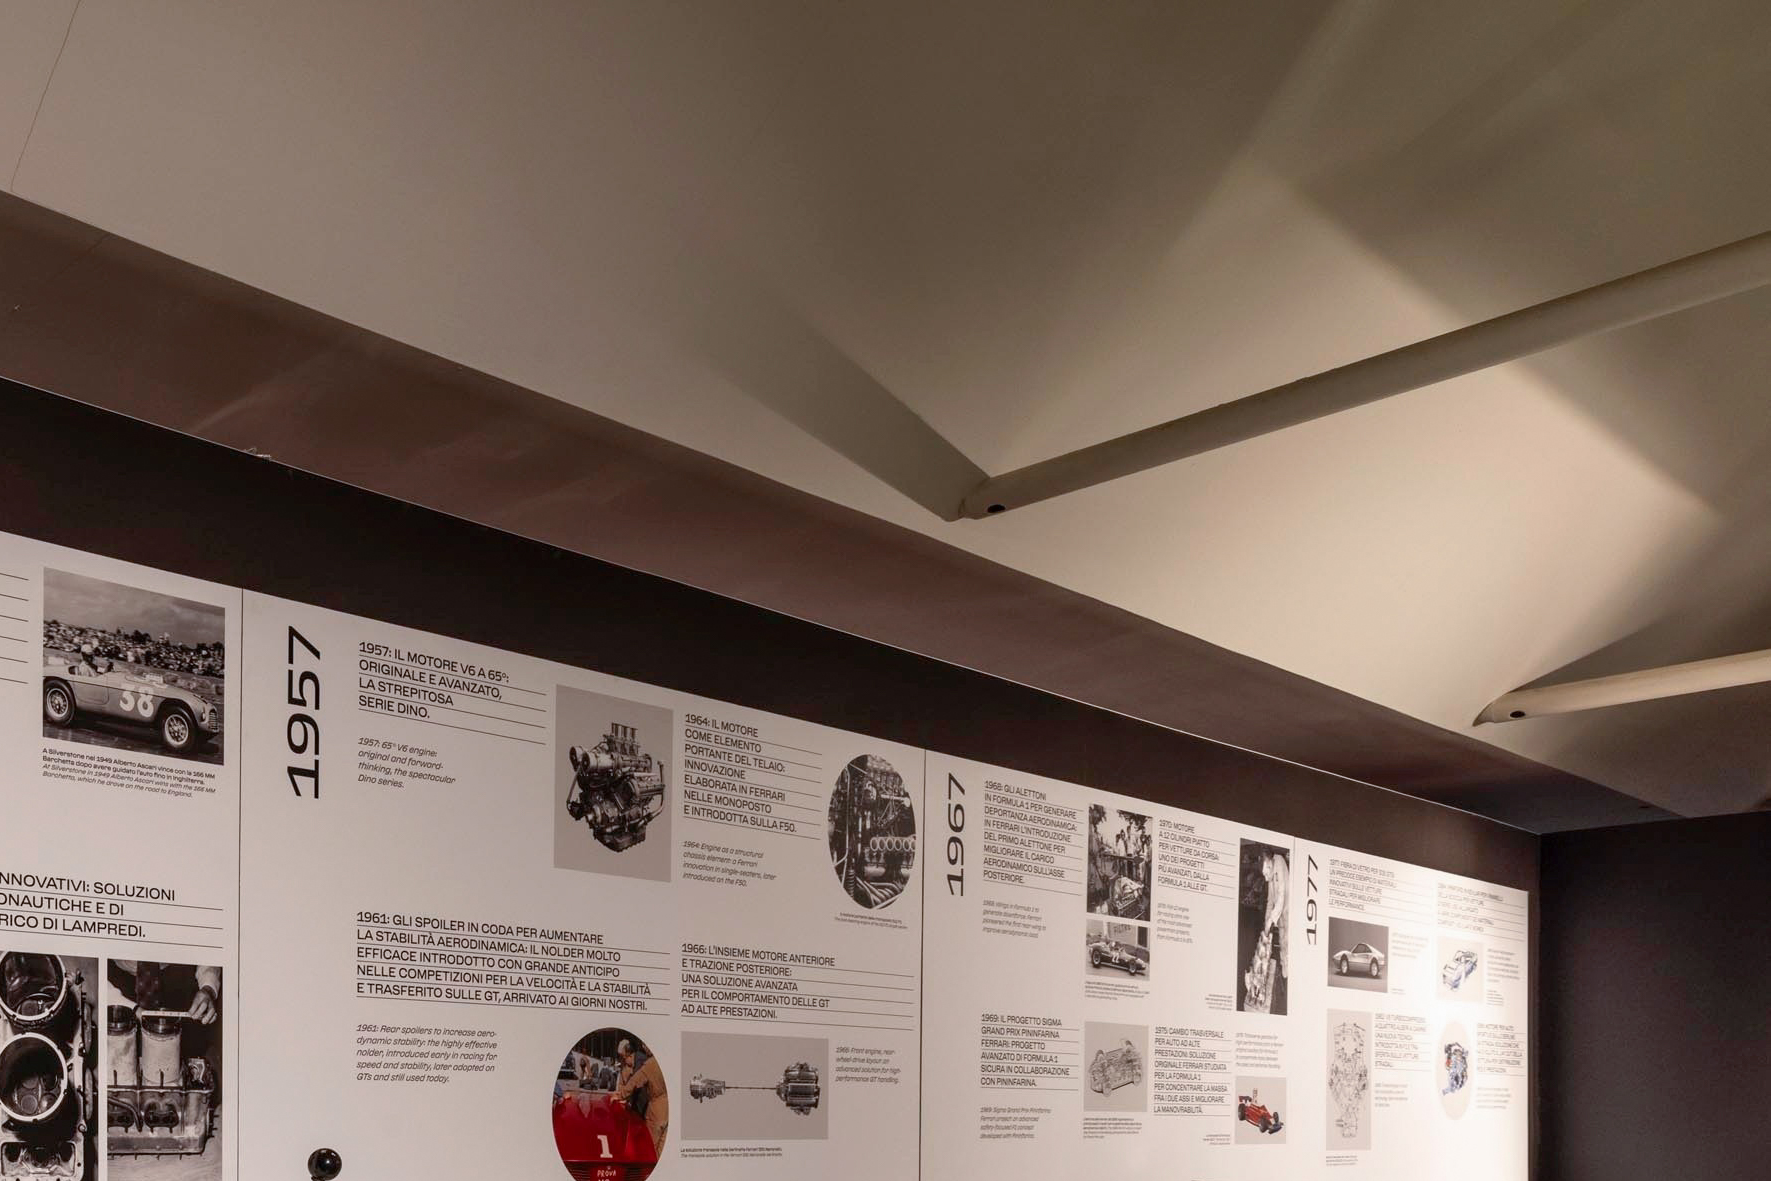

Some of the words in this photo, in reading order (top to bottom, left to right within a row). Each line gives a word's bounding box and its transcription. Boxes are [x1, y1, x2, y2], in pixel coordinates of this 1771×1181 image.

[359, 642, 391, 657] 1957:
[395, 649, 405, 661] IL
[408, 652, 458, 672] MOTORE
[460, 663, 476, 676] V6
[477, 668, 486, 678] A
[488, 670, 509, 683] 65°:
[359, 659, 426, 683] ORIGINALE
[429, 674, 436, 685] E
[438, 676, 502, 700] AVANZATO,
[359, 677, 377, 690] LA
[378, 681, 453, 706] STREPITOSA
[287, 626, 321, 800] 1957
[359, 695, 395, 712] SERIE
[398, 702, 430, 718] DINO.
[686, 714, 710, 726] 1964:
[712, 719, 720, 729] IL
[721, 721, 758, 737] MOTORE
[685, 728, 713, 743] COME
[714, 735, 761, 753] ELEMENTO
[685, 744, 733, 762] PORTANTE
[735, 754, 751, 766] DEL
[752, 758, 785, 772] TELAIO:
[947, 773, 965, 897] 1967
[93, 881, 175, 902] SOLUZIONI
[1307, 854, 1318, 945] 1977
[356, 911, 390, 925] 1961:
[392, 914, 413, 927] GLI
[414, 916, 466, 932] SPOILER
[467, 921, 479, 934] IN
[481, 923, 515, 937] CODA
[515, 926, 538, 939] PER
[538, 928, 604, 945] AUMENTARE
[357, 928, 374, 941] LA
[375, 930, 436, 947] STABILITÀ
[436, 935, 528, 954] AERODINAMICA:
[529, 943, 540, 956] IL
[541, 944, 585, 959] NOLDER
[586, 949, 620, 962] MOLTO
[681, 942, 707, 955] 1966:
[708, 945, 750, 959] L'INSIEME
[751, 949, 788, 963] MOTORE
[789, 952, 835, 967] ANTERIORE
[681, 1003, 695, 1015] AD
[696, 1004, 718, 1016] ALTE
[719, 1005, 777, 1019] PRESTAZIONI.
